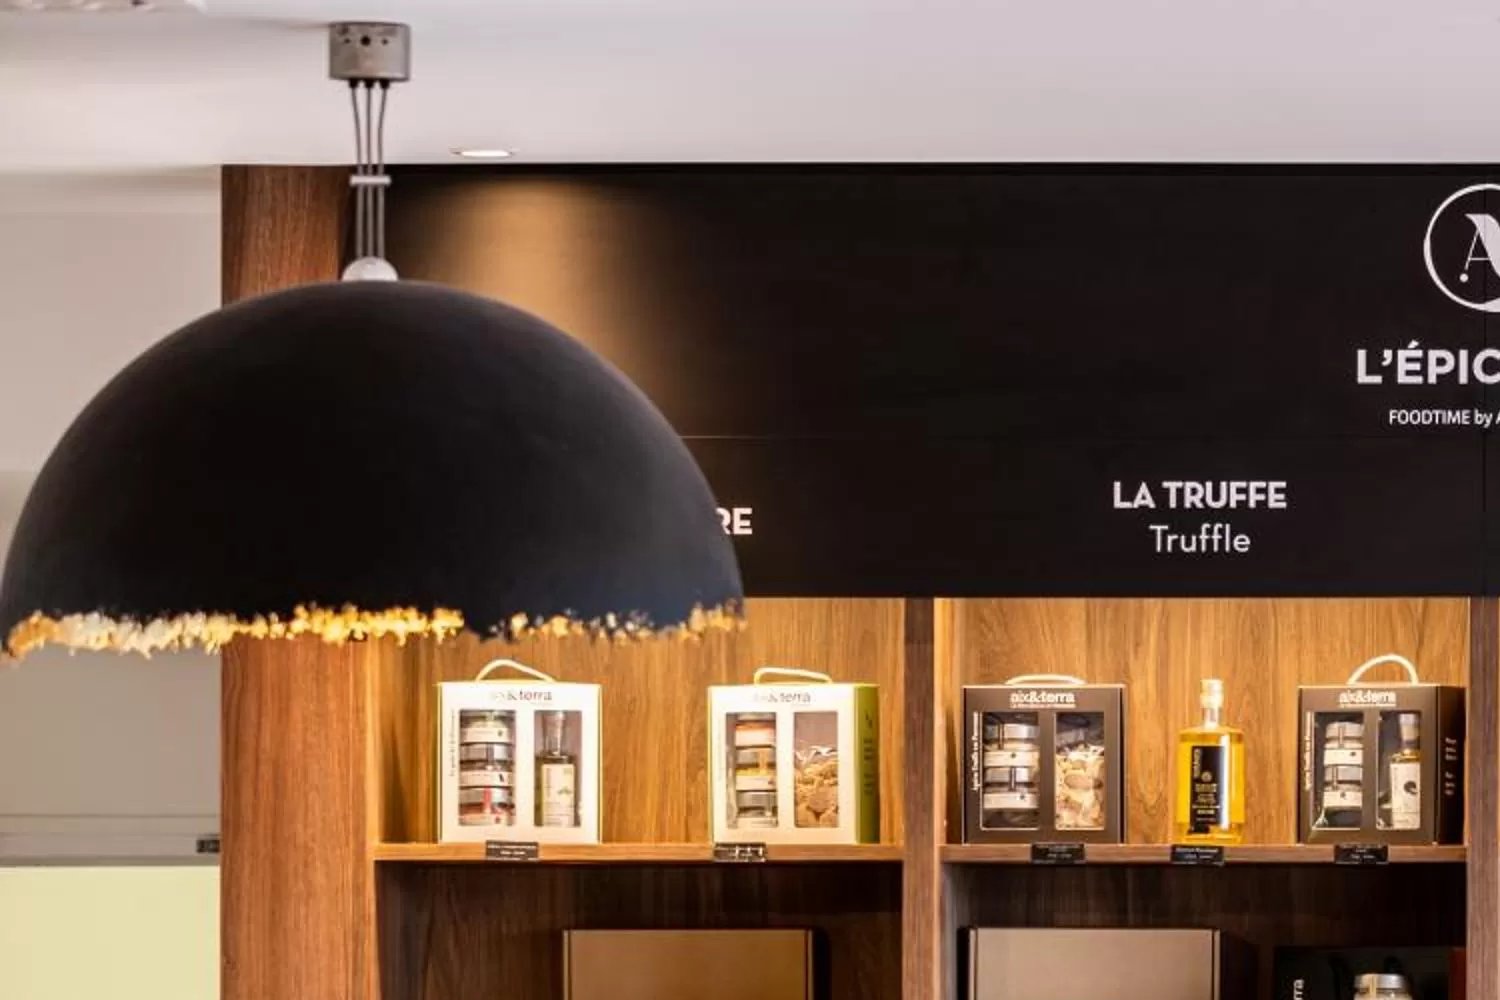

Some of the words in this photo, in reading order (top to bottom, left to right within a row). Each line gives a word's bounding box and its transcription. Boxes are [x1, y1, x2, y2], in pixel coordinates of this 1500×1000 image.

[1389, 409, 1470, 425] FOODTIME
[1474, 409, 1493, 429] by
[1113, 482, 1155, 508] LA
[1162, 481, 1286, 508] TRUFFE
[1149, 523, 1250, 552] Truffle
